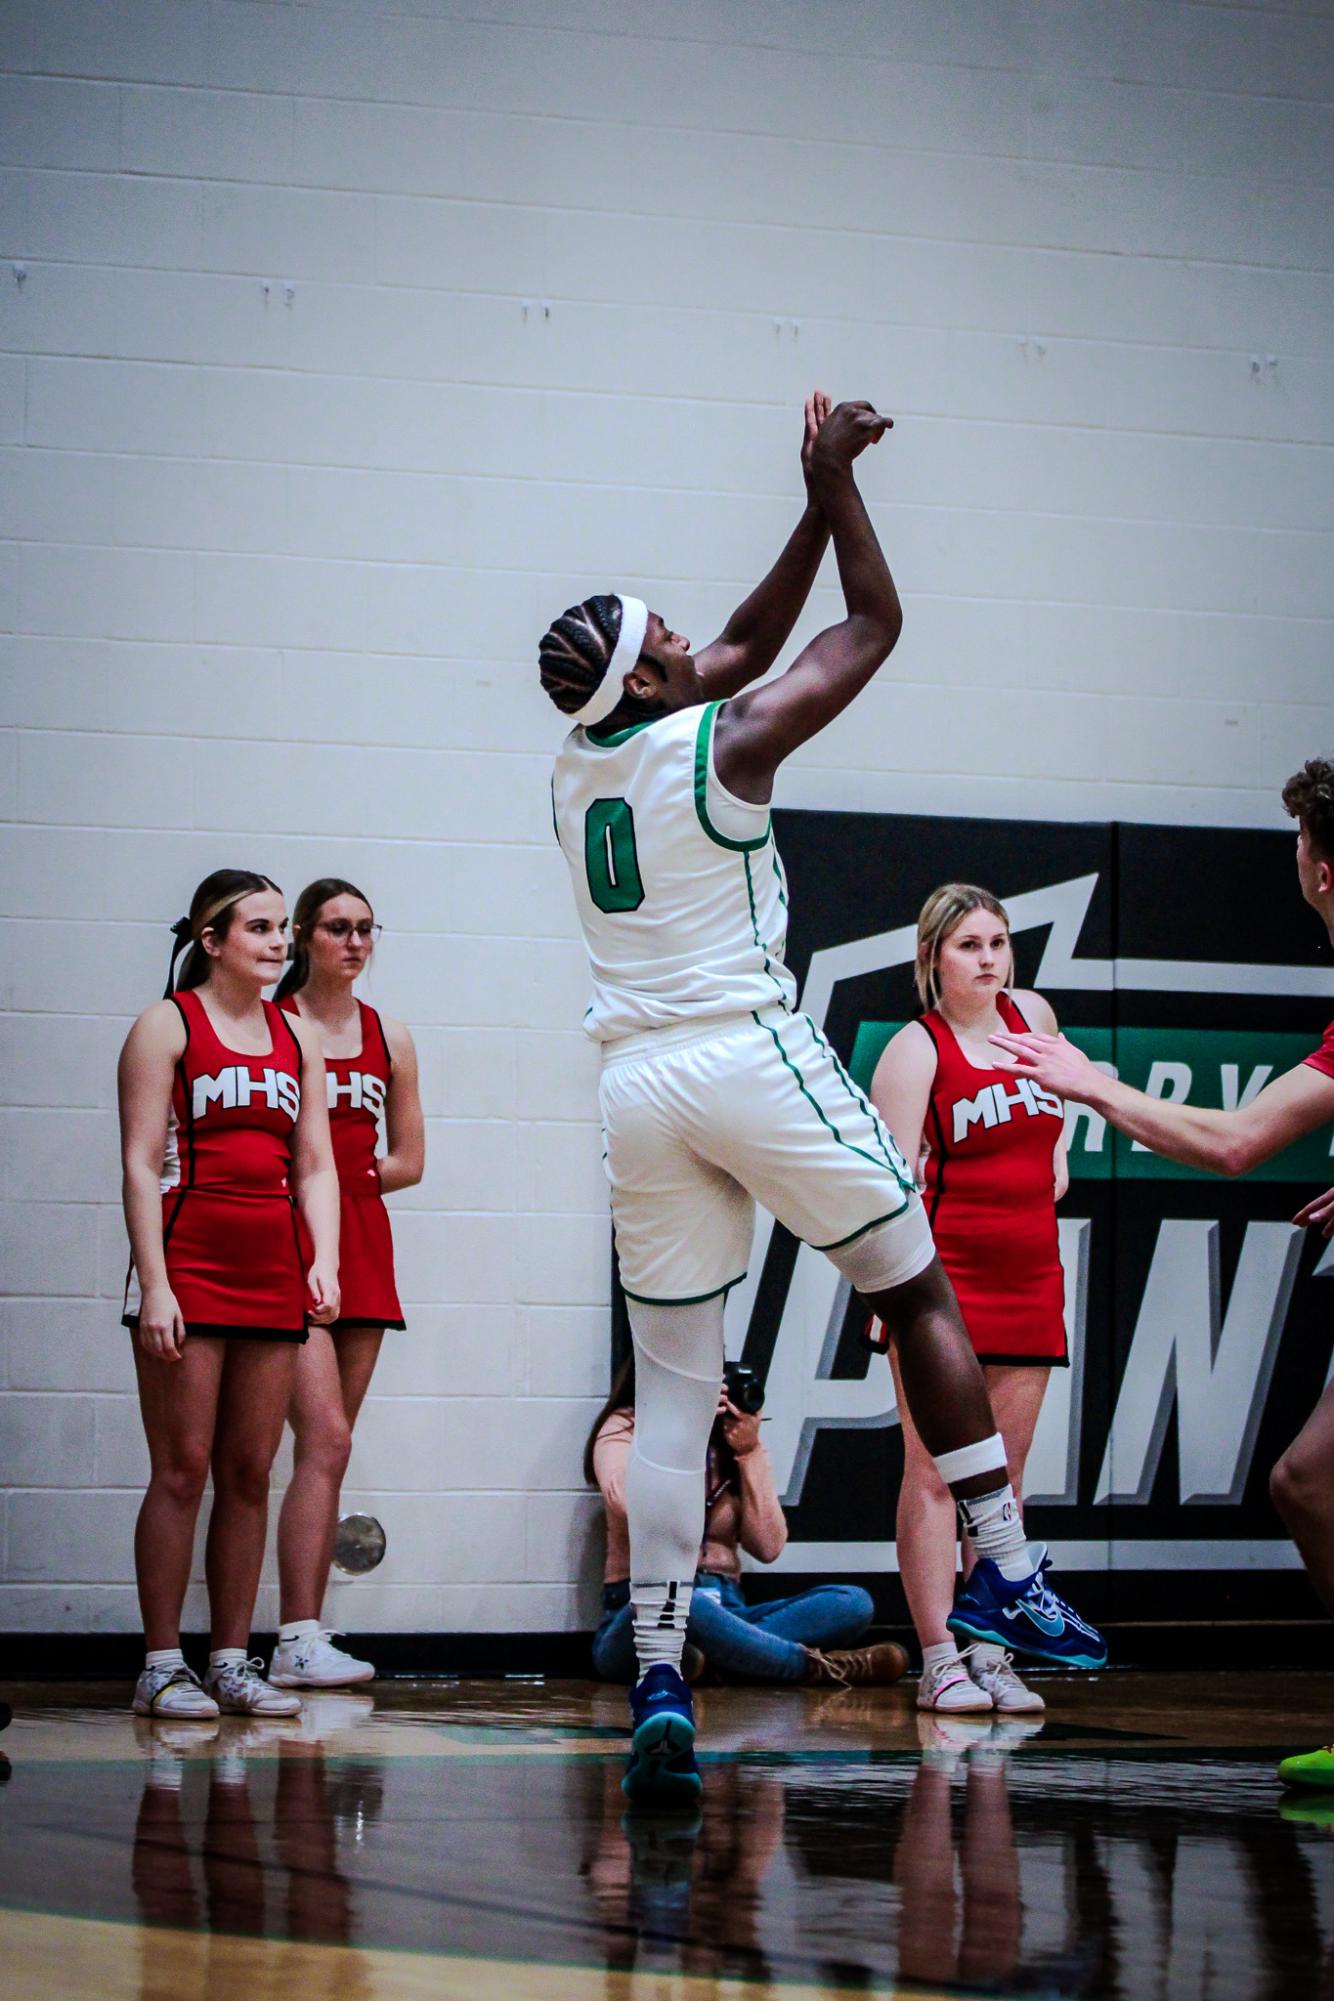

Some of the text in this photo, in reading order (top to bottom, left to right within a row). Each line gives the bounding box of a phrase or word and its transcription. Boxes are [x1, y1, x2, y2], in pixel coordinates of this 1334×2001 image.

[585, 797, 645, 913] 0
[192, 1065, 301, 1123] MHS
[325, 1071, 387, 1120] HS
[952, 1078, 1064, 1143] MHS
